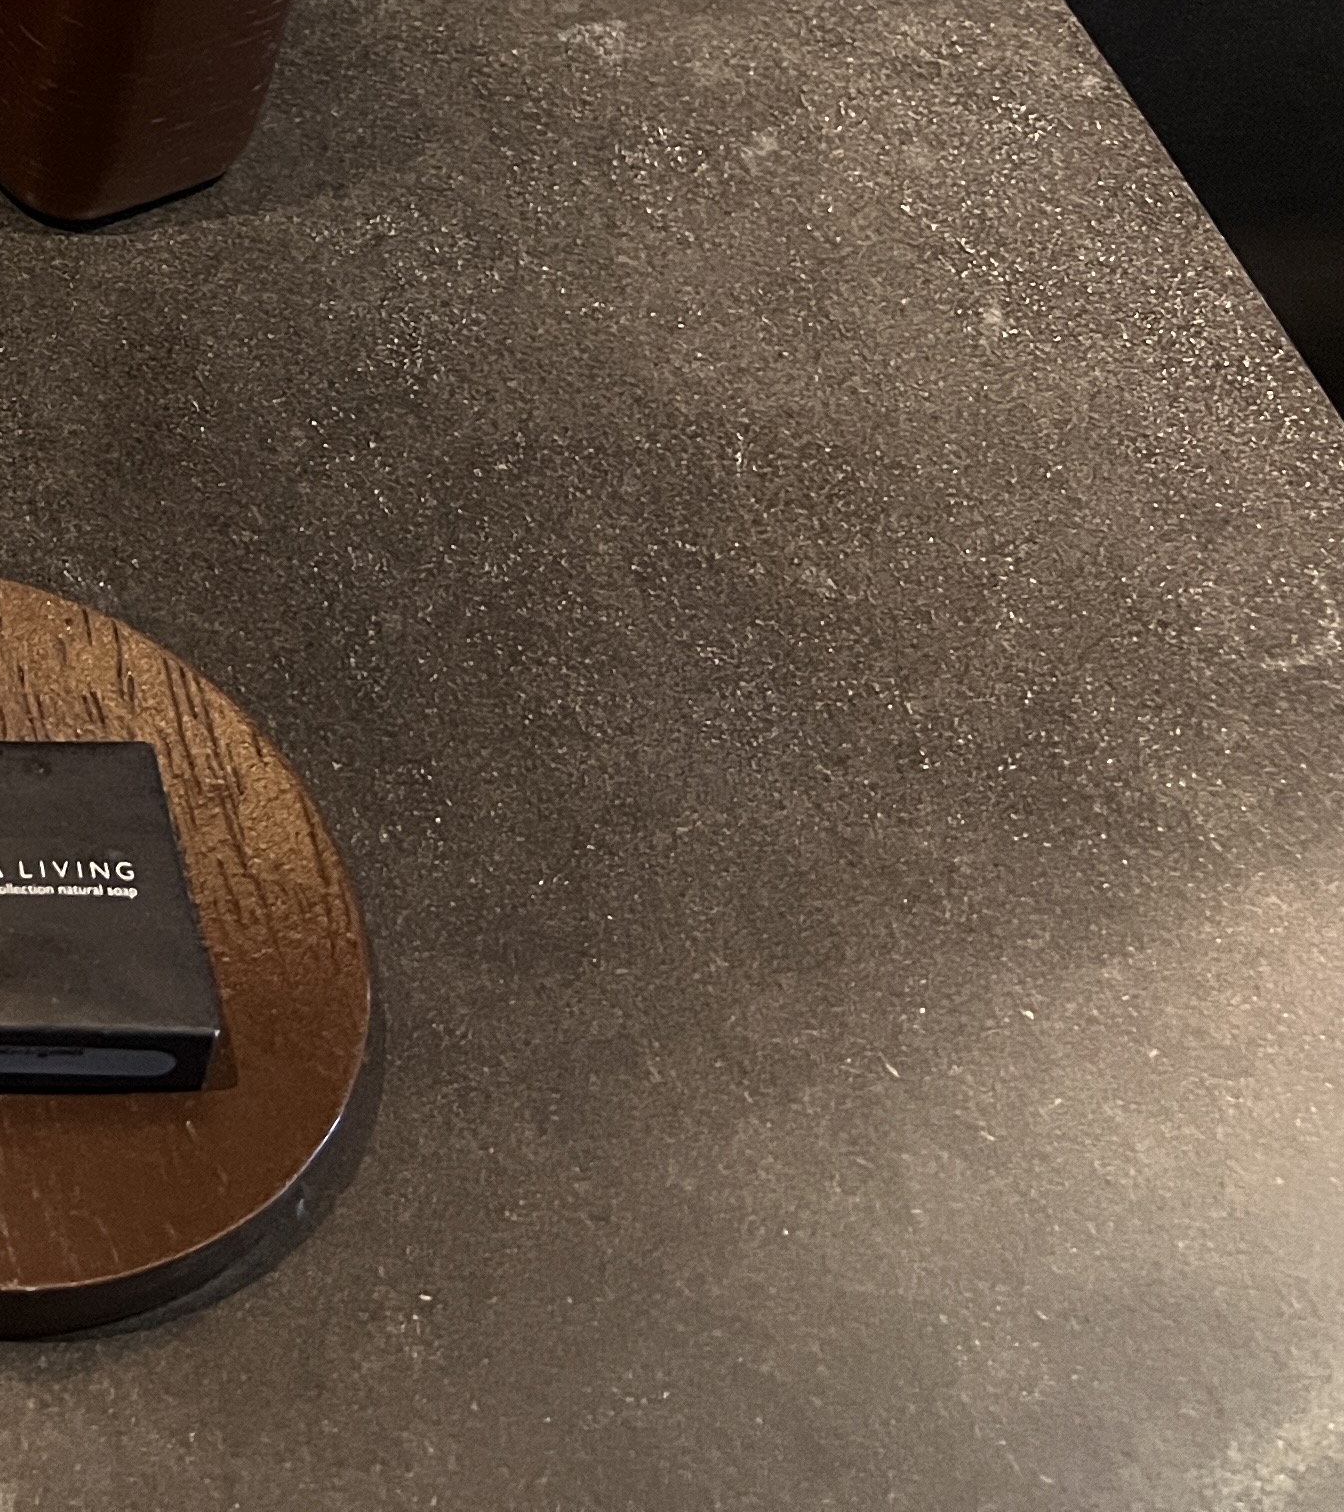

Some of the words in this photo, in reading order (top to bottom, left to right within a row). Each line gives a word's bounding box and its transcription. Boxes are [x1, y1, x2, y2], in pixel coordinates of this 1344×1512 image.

[18, 860, 136, 881] LIVING
[58, 884, 104, 896] natural
[107, 886, 138, 899] soap
